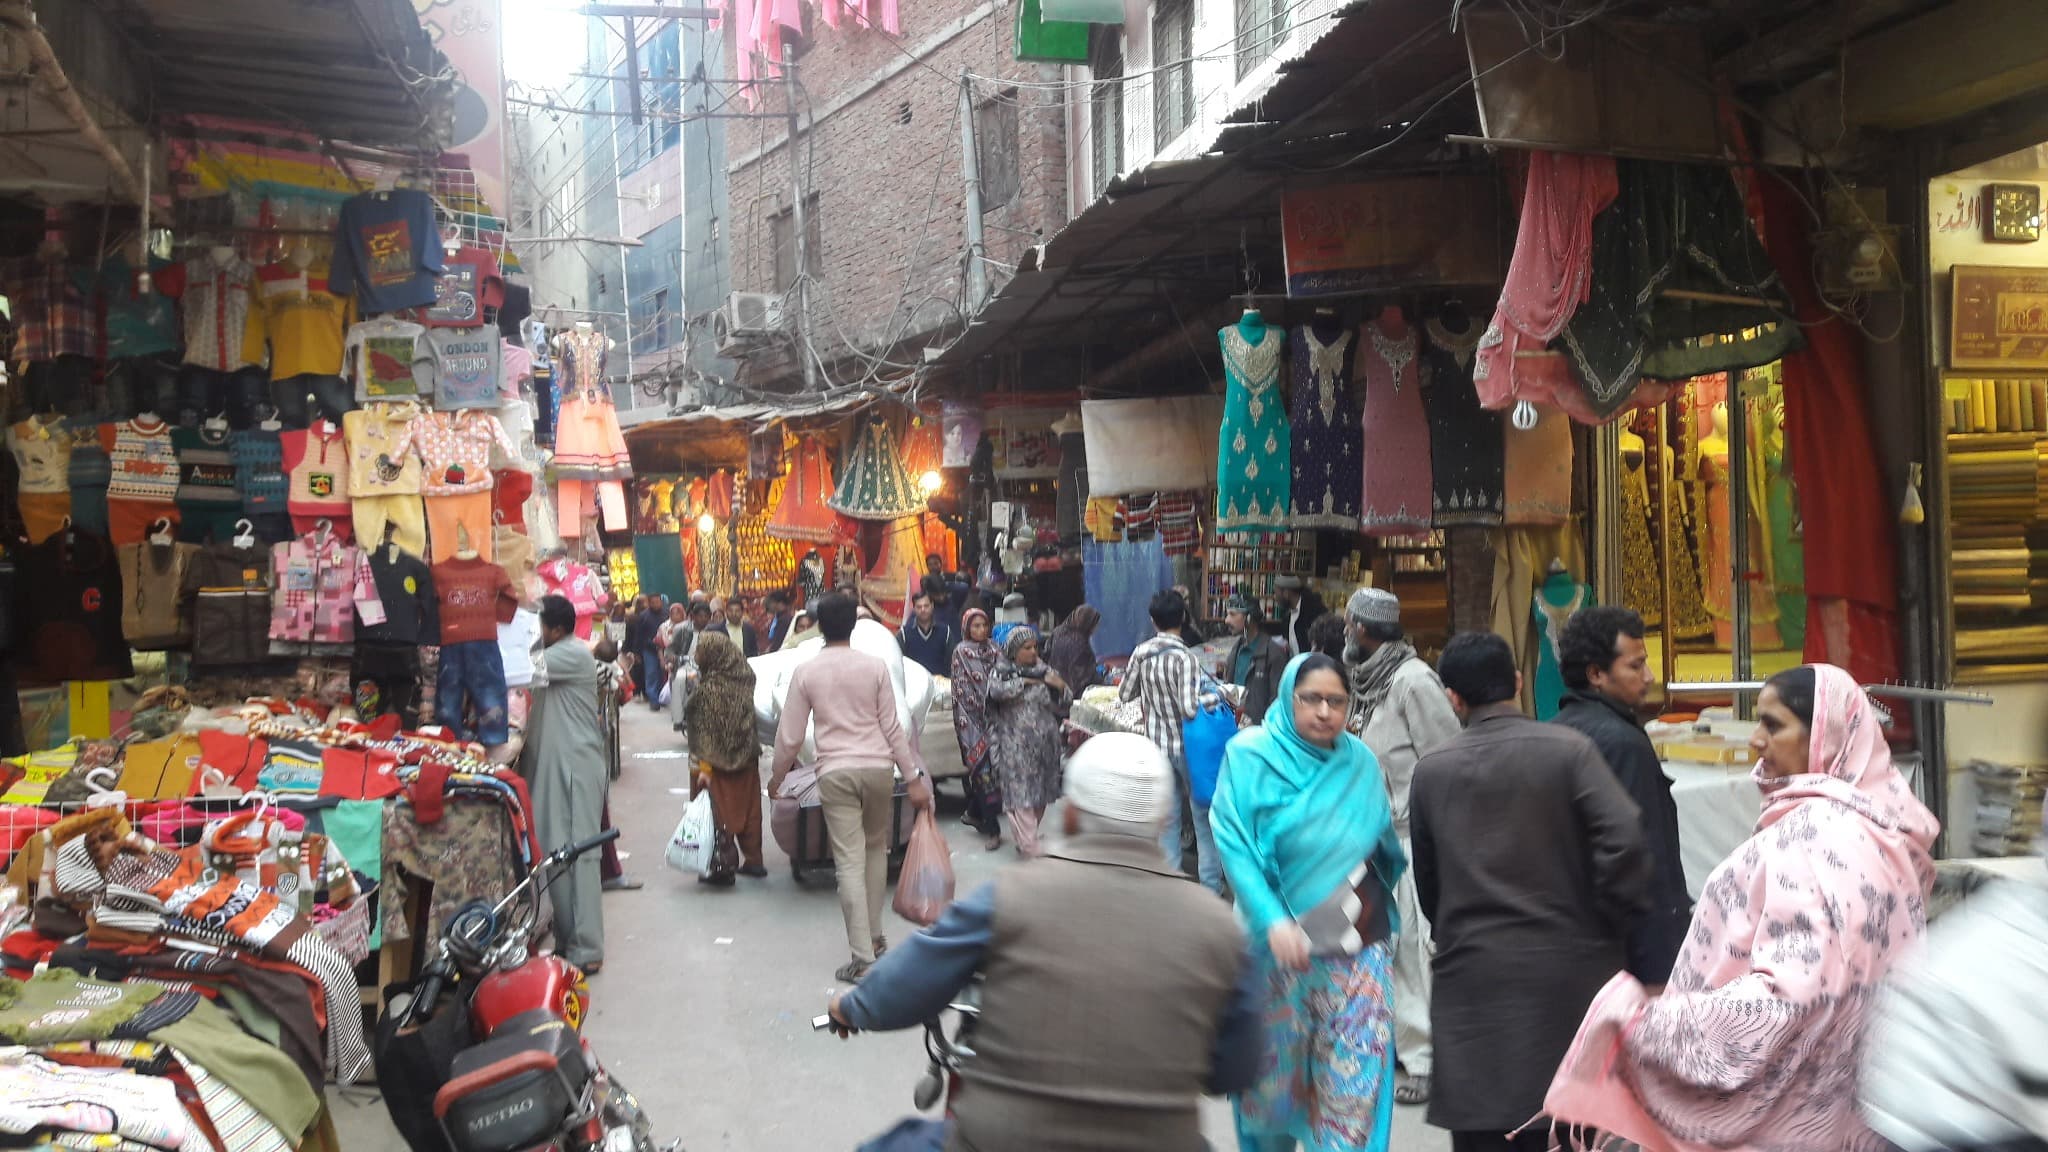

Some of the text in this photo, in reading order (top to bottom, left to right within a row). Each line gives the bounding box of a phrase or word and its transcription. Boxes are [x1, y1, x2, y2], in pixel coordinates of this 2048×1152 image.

[440, 342, 488, 356] LONDON
[445, 357, 488, 373] AROUND
[468, 1097, 534, 1135] METRO
